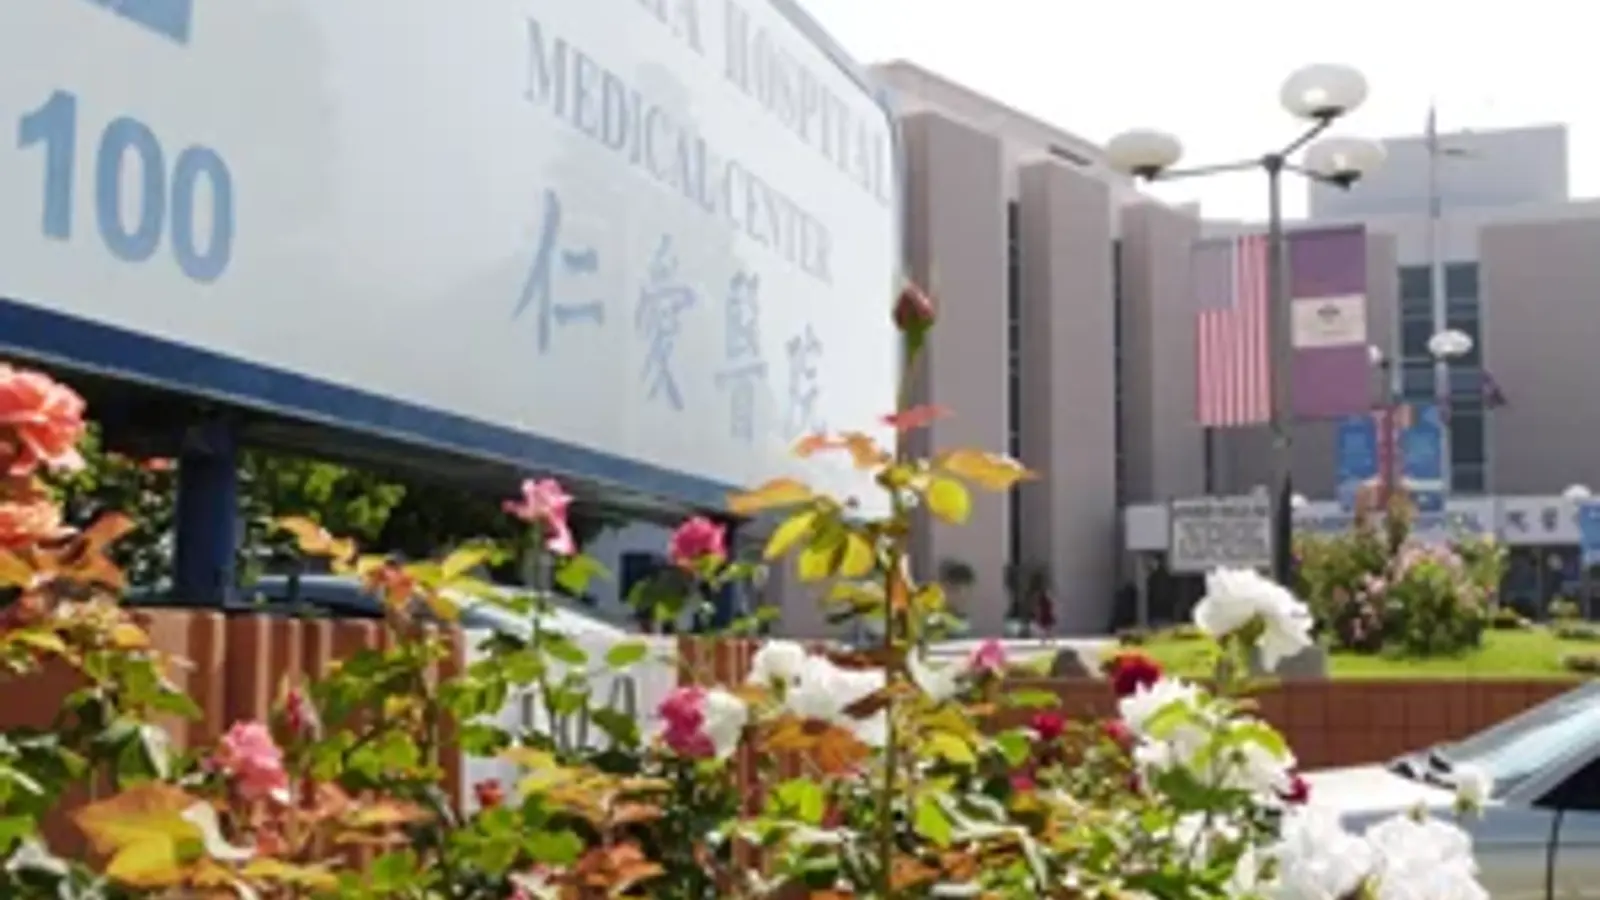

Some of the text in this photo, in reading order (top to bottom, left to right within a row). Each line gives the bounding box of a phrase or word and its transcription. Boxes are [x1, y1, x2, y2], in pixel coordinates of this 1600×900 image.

[17, 88, 234, 284] 100
[523, 16, 834, 288] MEDICAL CENTER
[723, 0, 891, 208] HOSPITAL
